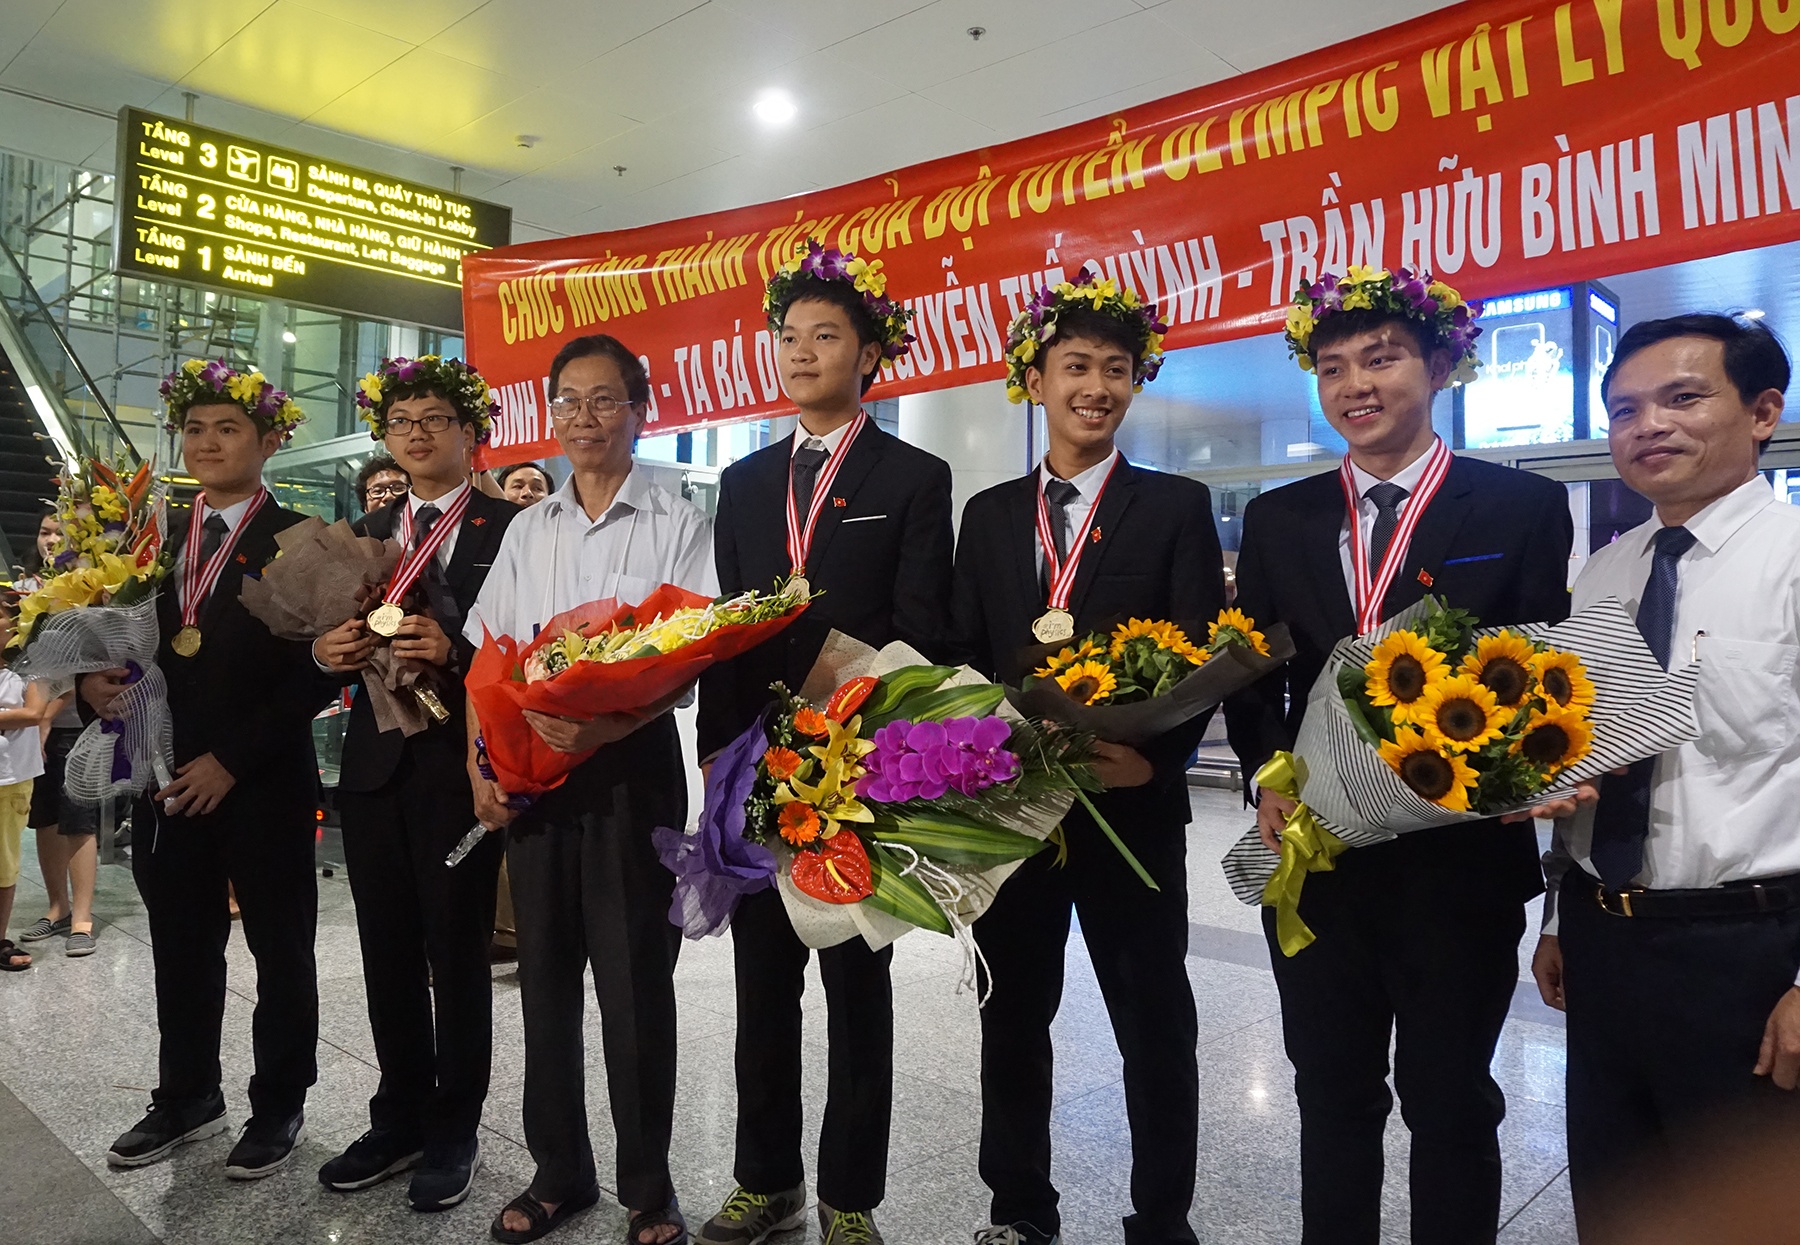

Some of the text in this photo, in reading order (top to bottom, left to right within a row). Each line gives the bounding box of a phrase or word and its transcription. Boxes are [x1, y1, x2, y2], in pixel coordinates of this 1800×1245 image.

[140, 141, 185, 166] Level
[141, 120, 218, 168] TẦNG 3
[137, 194, 182, 217] Level
[139, 173, 216, 220] TẦNG 2
[308, 164, 350, 188] SẢNH
[415, 193, 442, 212] THỦ
[444, 201, 472, 219] TỤC
[498, 259, 565, 345] CHÚC
[564, 250, 648, 329] MỪNG
[650, 231, 755, 306] THÀNH
[838, 177, 924, 257] CỦA
[923, 165, 1006, 251] ĐỘI
[1008, 118, 1157, 219] TUYỂN
[1160, 60, 1400, 181] OLYMPIC
[1421, 22, 1533, 132] VẬT
[263, 203, 312, 229] HÀNG,
[315, 216, 347, 235] NHÀ
[350, 224, 394, 248] HÀNG,
[424, 240, 461, 261] HÀNH
[307, 183, 378, 214] Departure,
[438, 216, 477, 239] Lobby
[135, 248, 180, 269] Level
[136, 225, 212, 271] TẦNG 1
[223, 244, 306, 275] SẢNH ĐẾN
[224, 214, 446, 276] Shops, Restaurant, Left Baggage
[222, 266, 273, 287] Arrival
[674, 344, 713, 423] TẠ
[712, 319, 756, 410] BÁ
[873, 255, 1003, 384] GUYỄN
[1083, 229, 1223, 327] UỲNH
[1260, 172, 1386, 306] TRẦN
[1402, 154, 1502, 276] HỮU
[1521, 134, 1660, 259] BÌNH
